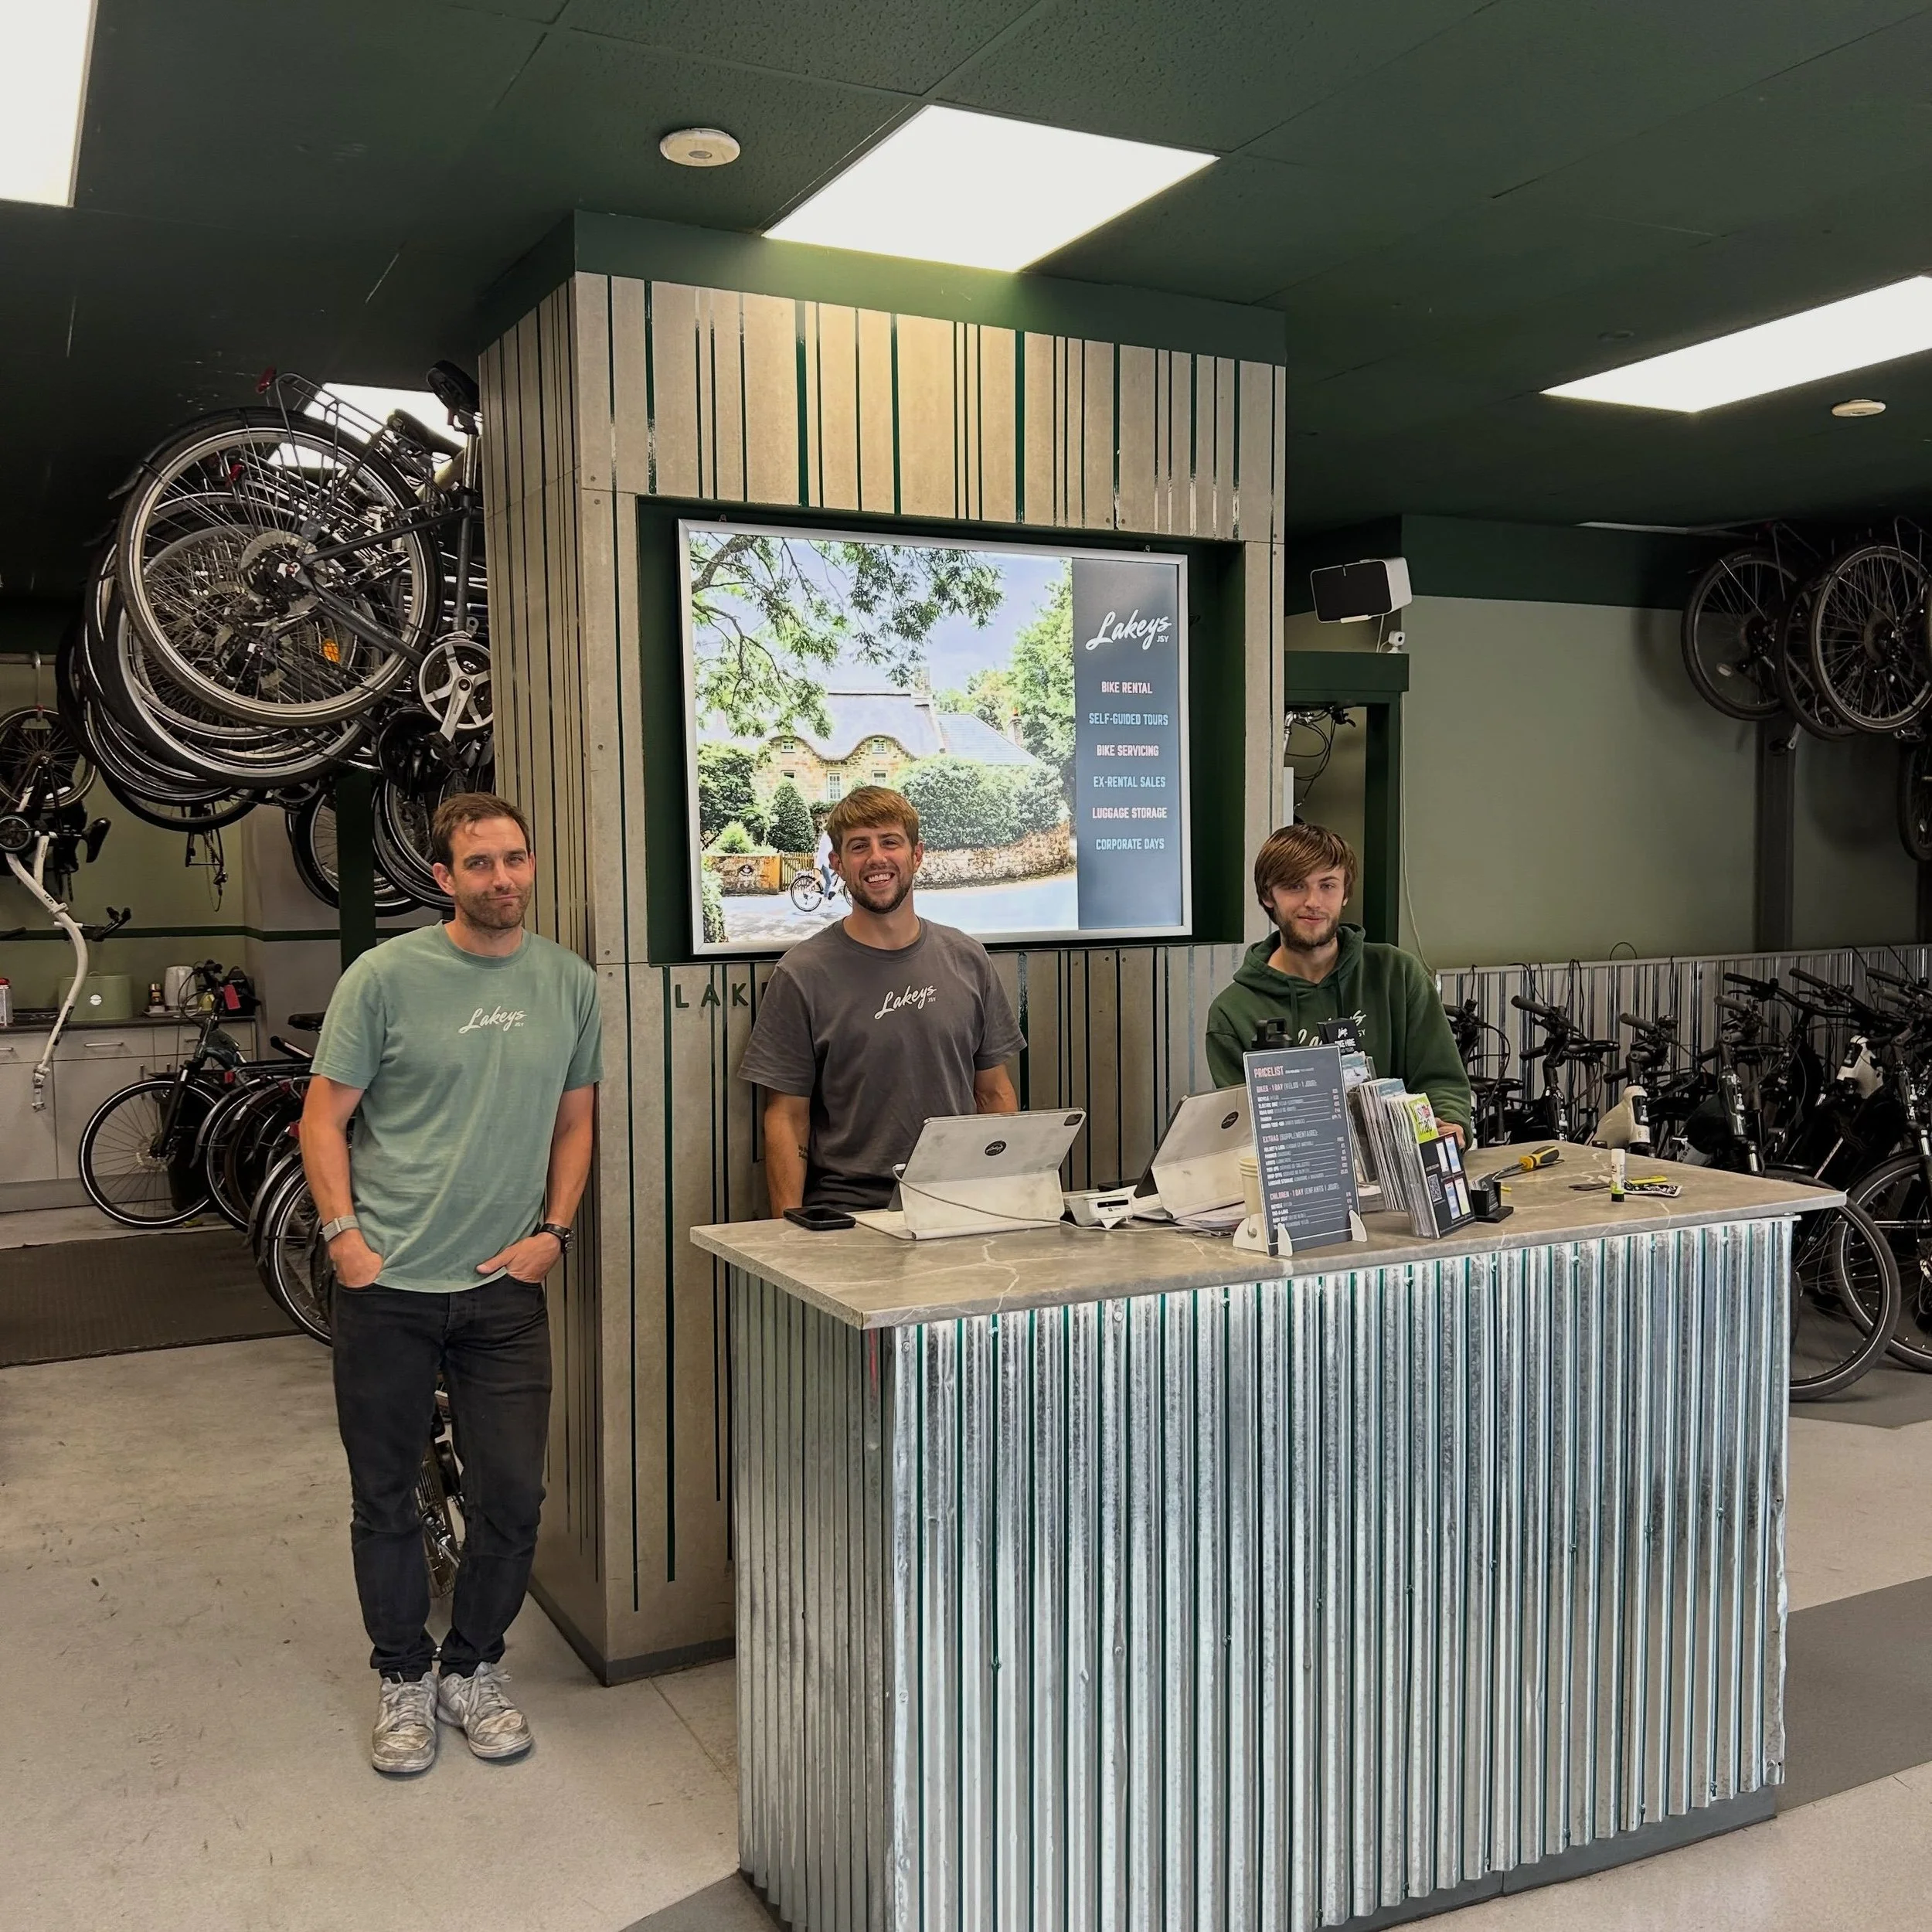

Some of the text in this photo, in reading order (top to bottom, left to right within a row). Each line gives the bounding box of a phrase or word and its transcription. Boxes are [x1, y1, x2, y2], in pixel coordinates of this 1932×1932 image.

[1085, 608, 1172, 651] Lakeys
[1156, 634, 1169, 643] JSY
[1101, 681, 1153, 695] BIKE RENTAL
[1089, 713, 1168, 726] SELF-GUIDED TOURS
[1096, 744, 1159, 757] BIKE SERVICING
[1093, 776, 1166, 788] EX-RENTAL SALES
[1092, 807, 1168, 819] LUGGAGE STORAGE
[1096, 838, 1165, 851] CORPORATE DAYS
[874, 984, 937, 1020] Lakeys
[457, 1005, 528, 1034] Lakeys
[1253, 1066, 1284, 1078] PRICELIST
